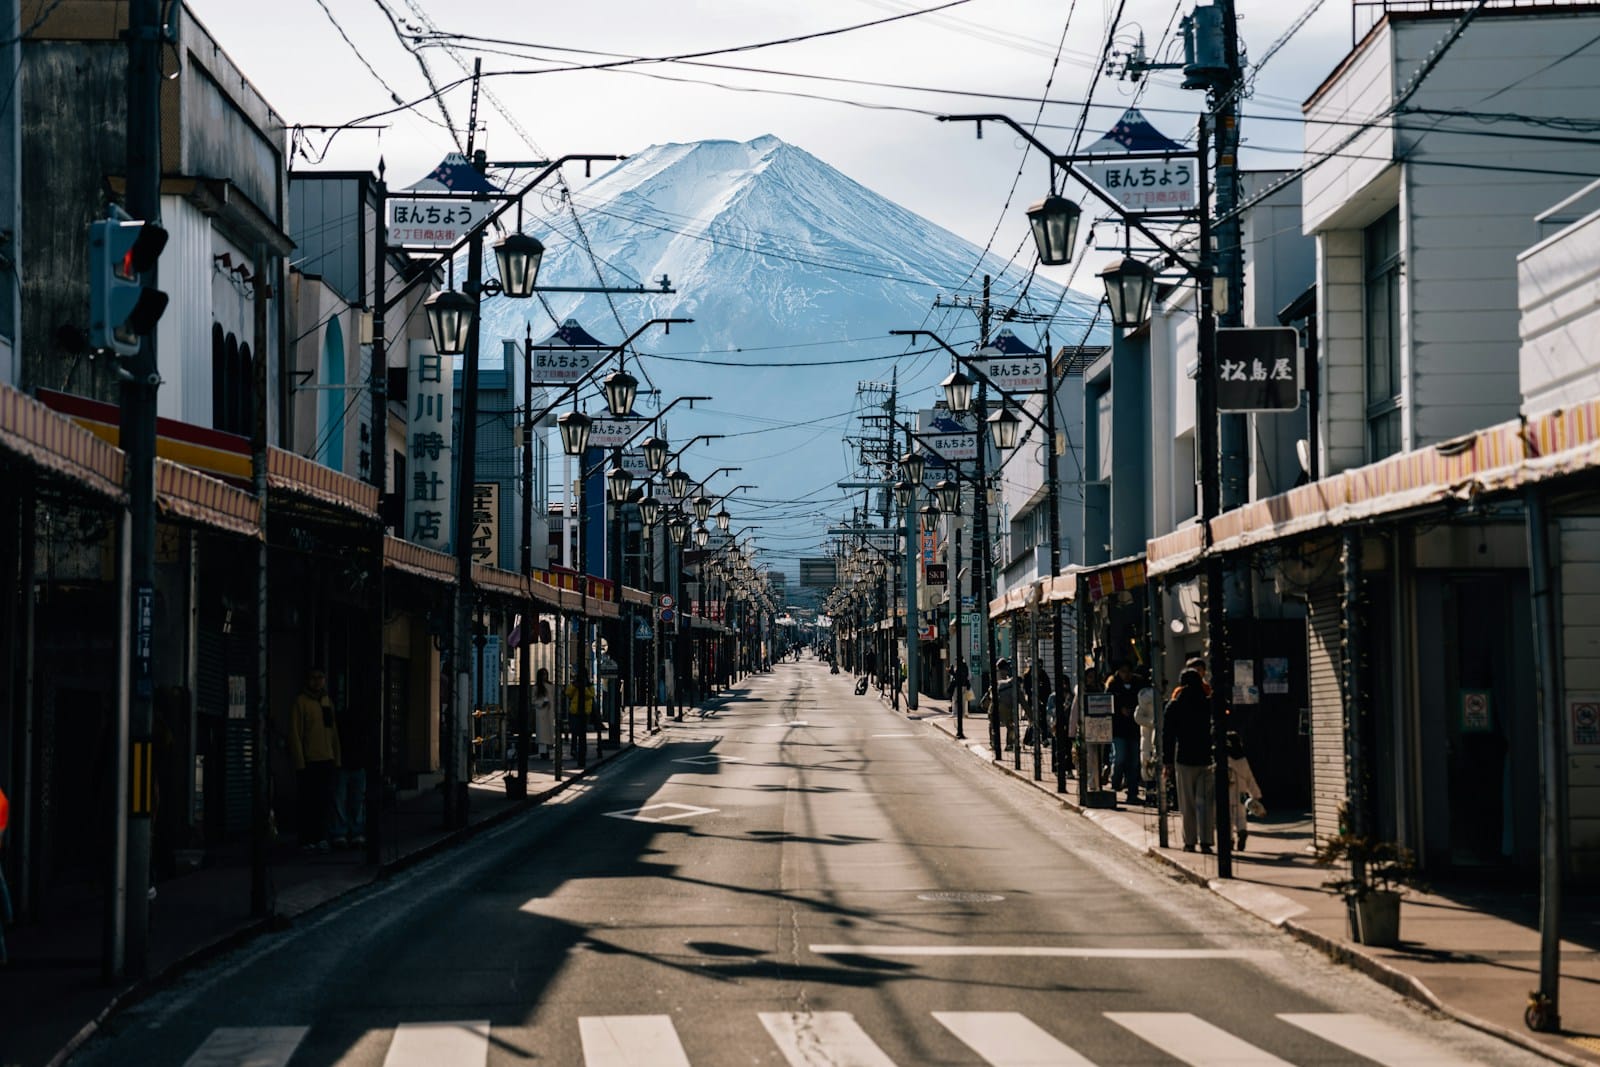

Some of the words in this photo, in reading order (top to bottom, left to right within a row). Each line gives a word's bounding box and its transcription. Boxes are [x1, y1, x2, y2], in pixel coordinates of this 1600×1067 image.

[1105, 164, 1191, 188] ほんちょう
[1121, 190, 1191, 205] 2丁目商店街
[393, 204, 472, 225] ほんちょう
[392, 228, 455, 241] 2丁目商店街
[536, 354, 591, 369] ほんちょう
[989, 363, 1042, 377] ほんちょう
[1219, 357, 1294, 382] 松島屋
[412, 355, 442, 540] 日川時計店
[935, 437, 975, 448] ほんちょう
